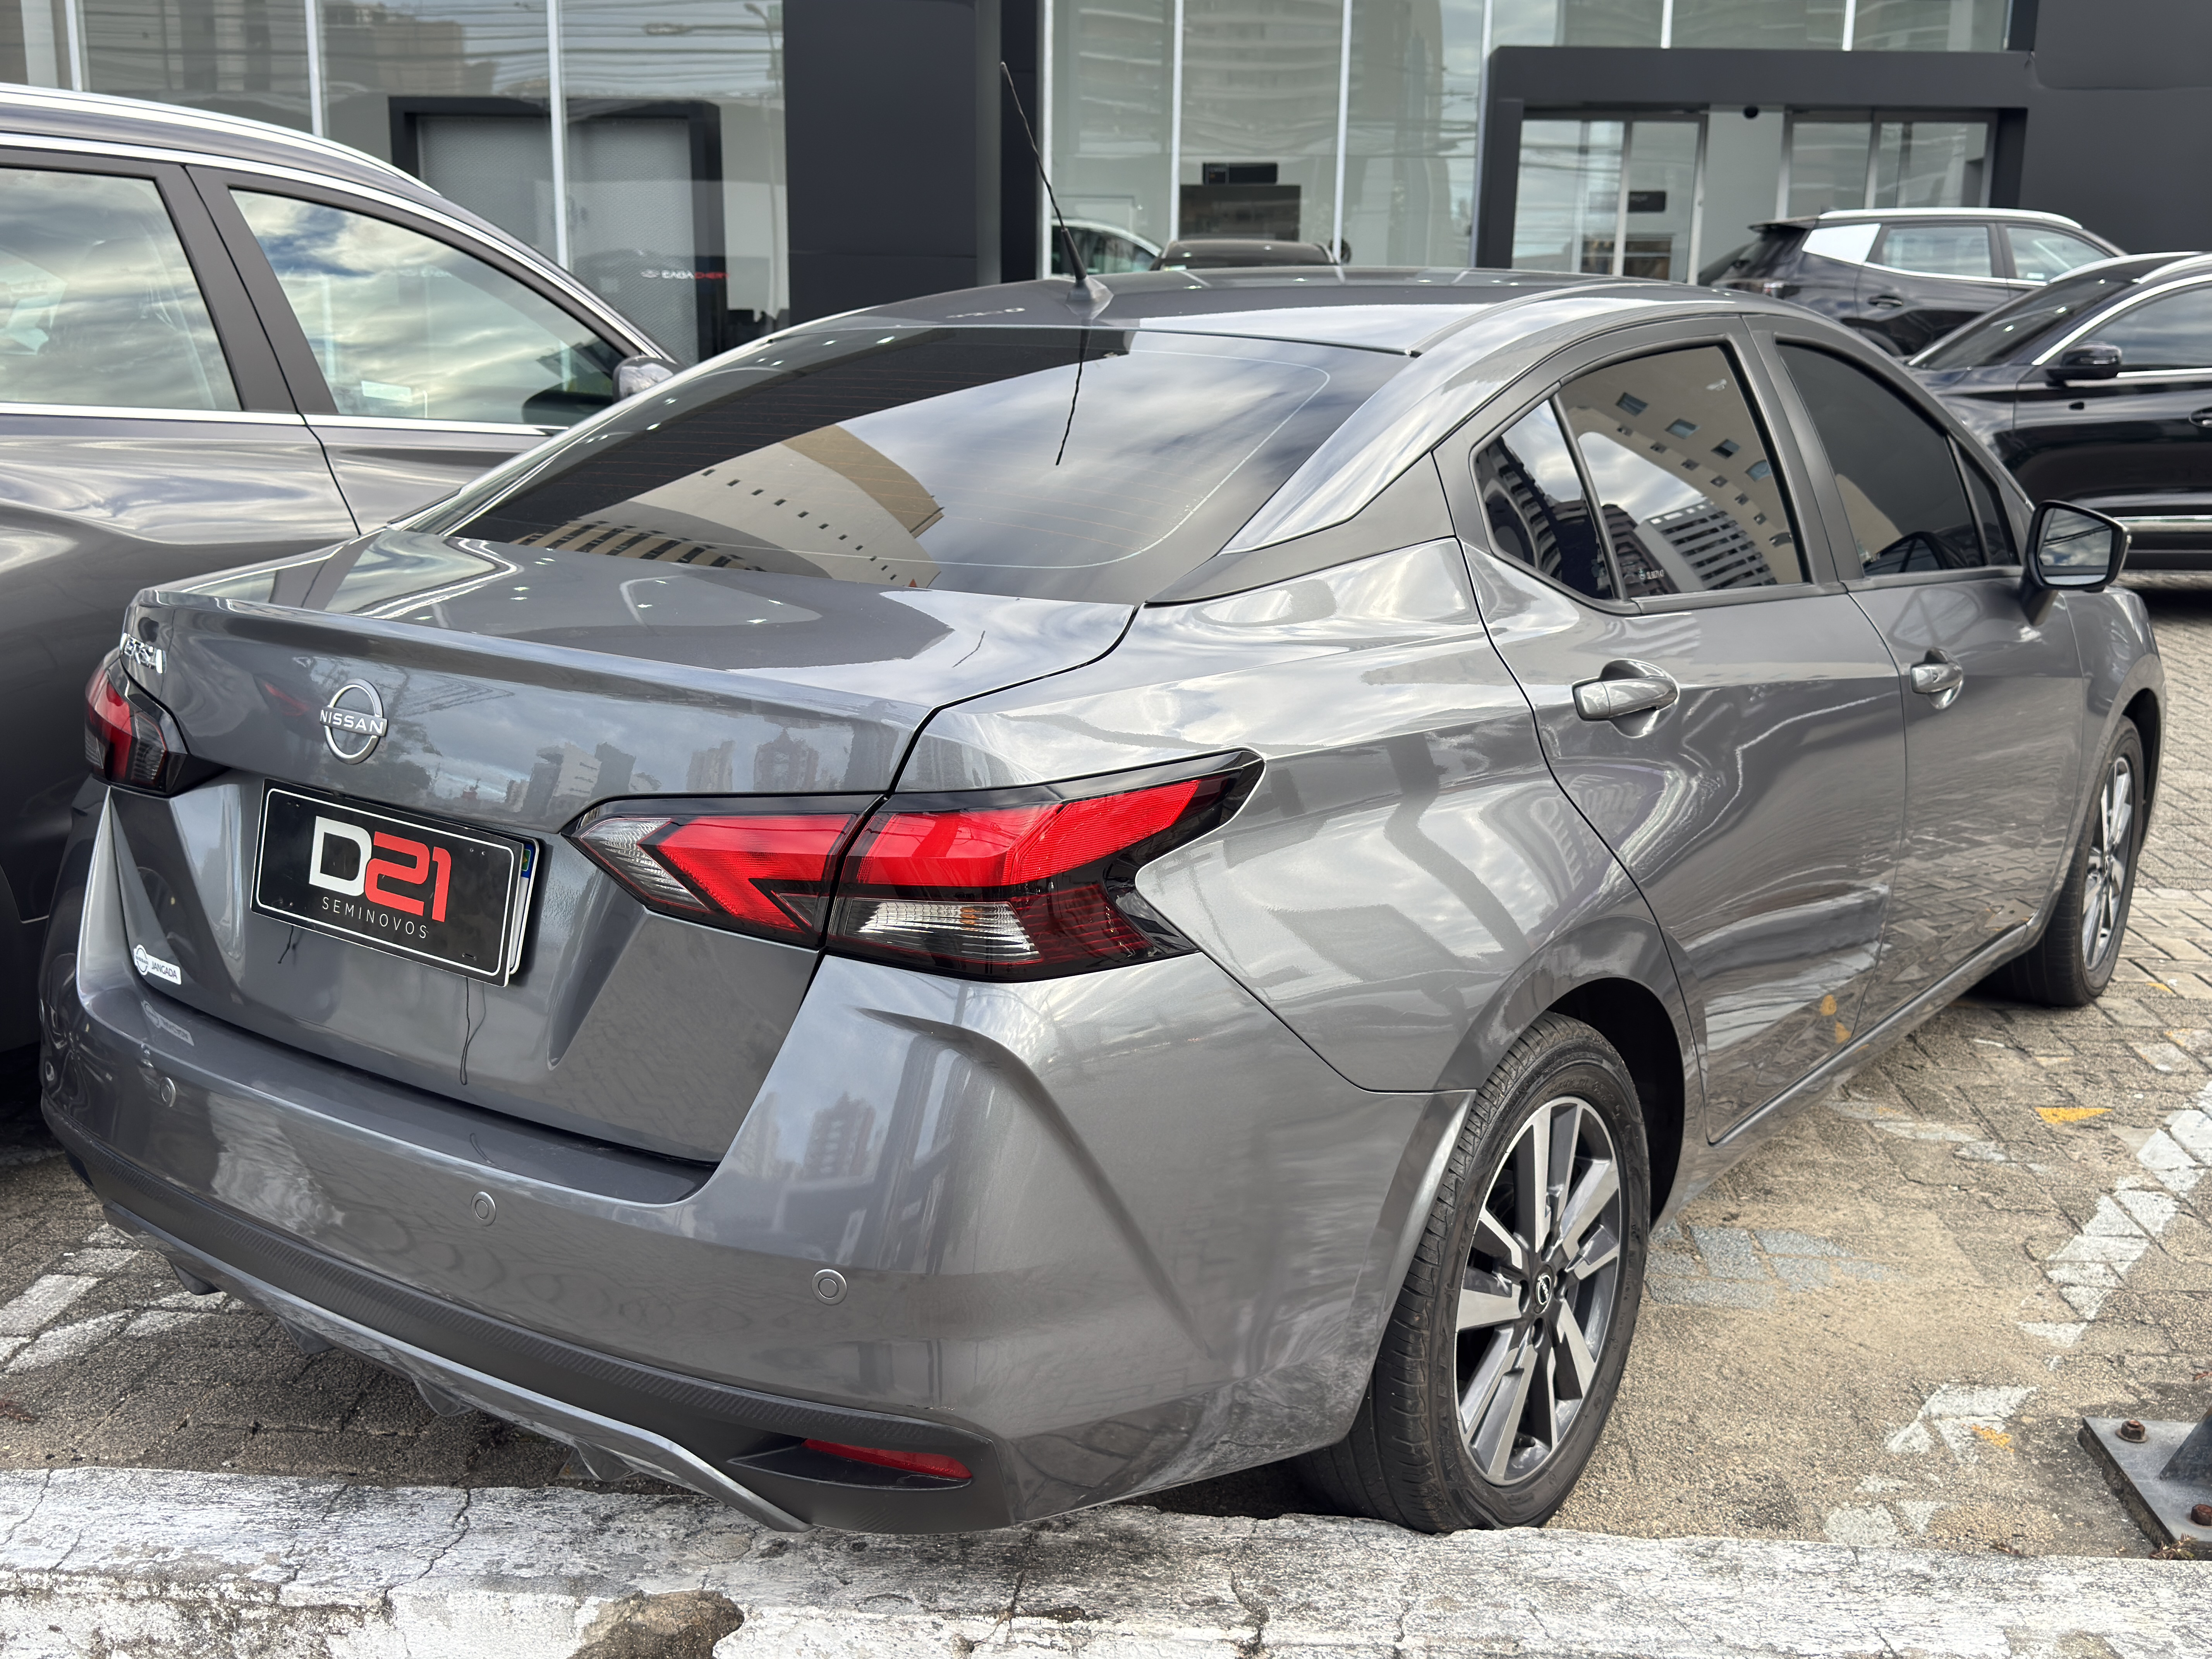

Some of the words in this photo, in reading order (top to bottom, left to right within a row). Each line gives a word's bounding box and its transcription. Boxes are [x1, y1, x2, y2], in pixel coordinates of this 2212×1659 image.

[320, 709, 383, 734] NISSAN
[309, 816, 452, 922] D21
[322, 896, 427, 938] SEMINOVOS
[151, 961, 178, 979] JANGADA
